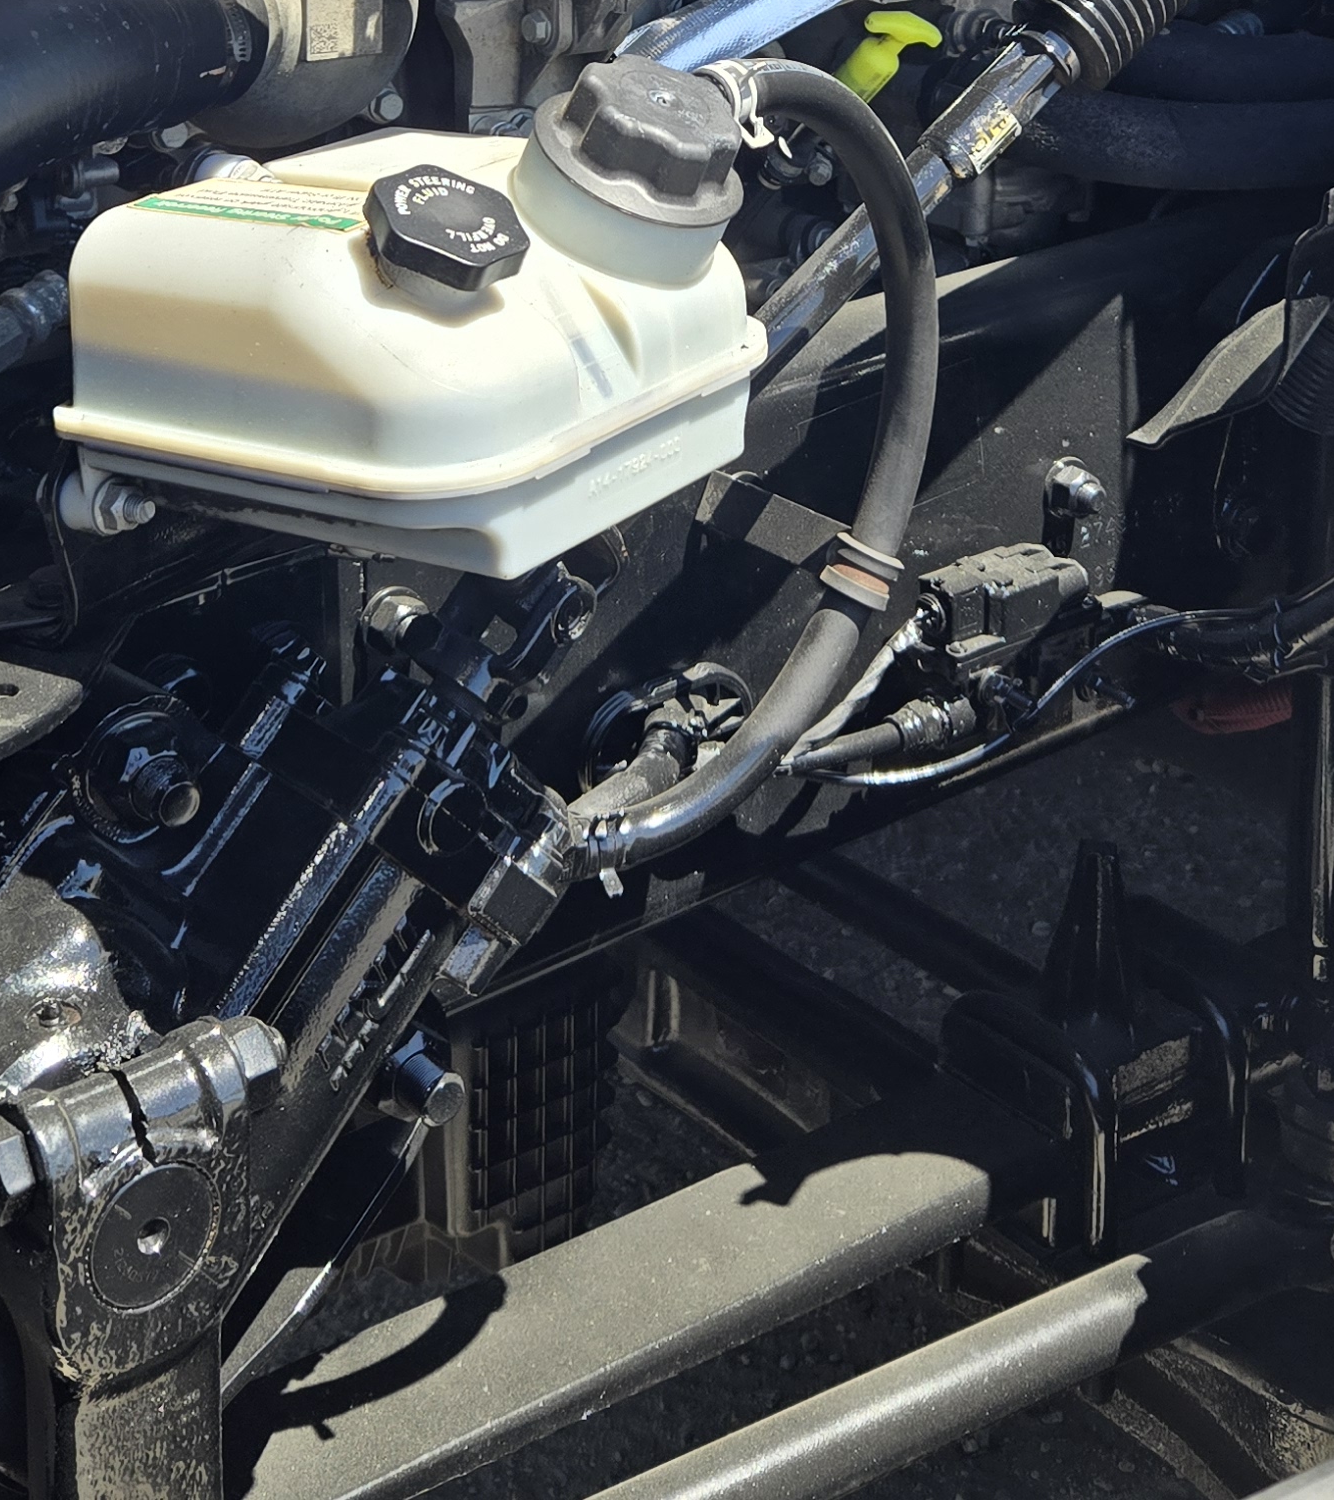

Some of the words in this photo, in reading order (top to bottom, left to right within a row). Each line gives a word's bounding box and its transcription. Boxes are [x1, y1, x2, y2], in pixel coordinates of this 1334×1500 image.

[394, 184, 411, 215] POWER
[409, 176, 476, 194] STEERING
[412, 187, 449, 205] FLUID
[228, 208, 292, 220] Steering
[293, 215, 343, 225] Power
[445, 216, 496, 242] OVERFILL
[493, 232, 510, 247] DO
[470, 243, 496, 253] NOT
